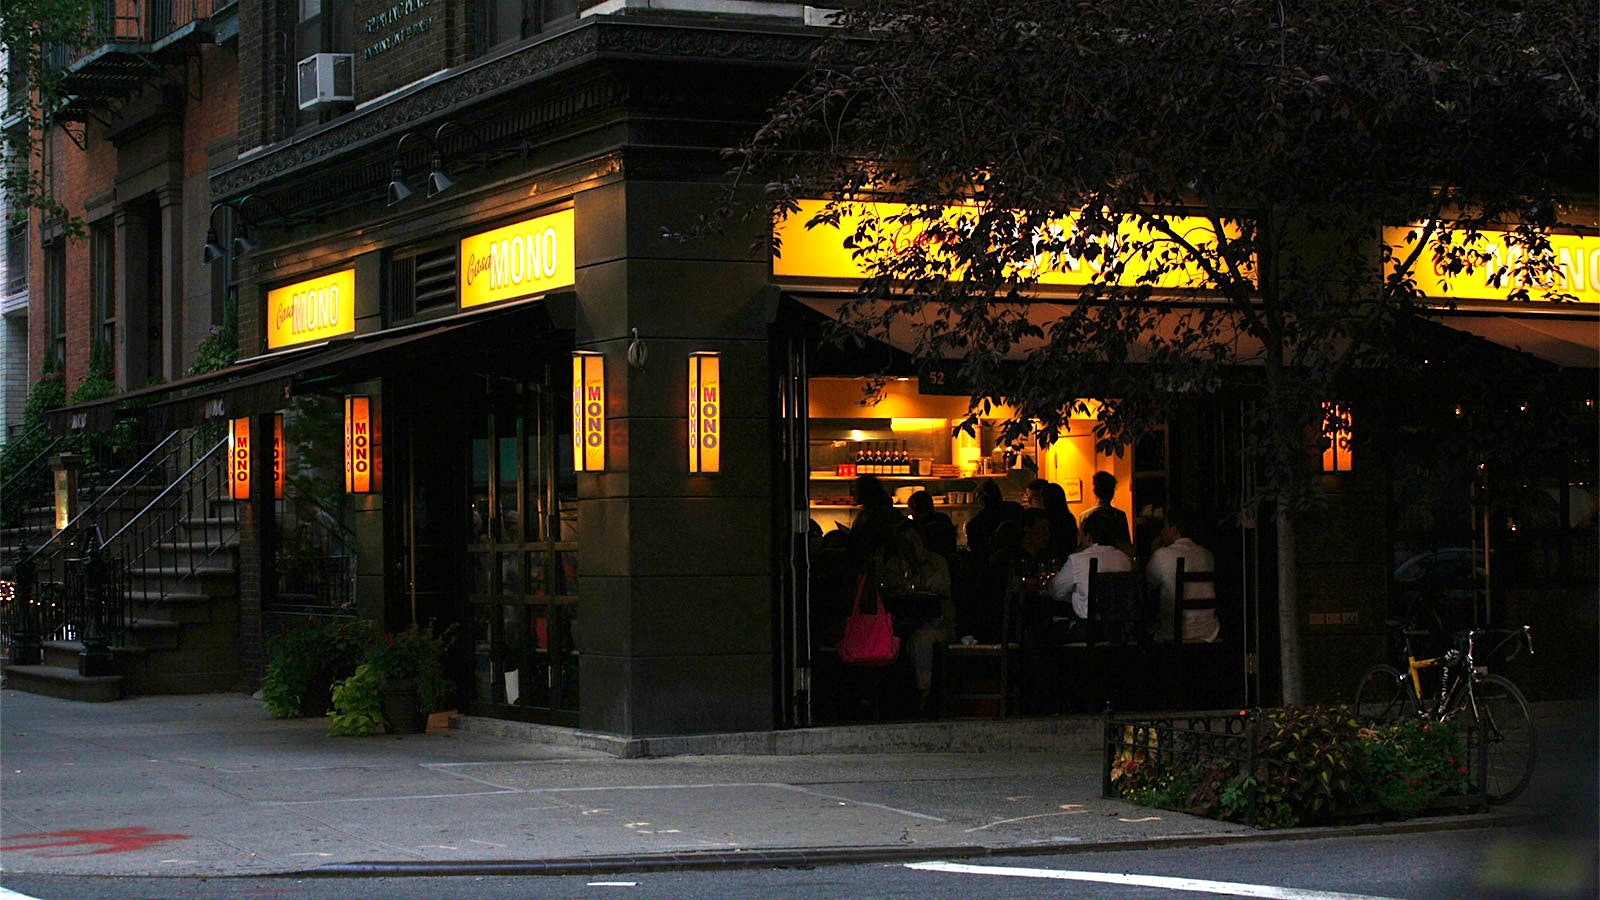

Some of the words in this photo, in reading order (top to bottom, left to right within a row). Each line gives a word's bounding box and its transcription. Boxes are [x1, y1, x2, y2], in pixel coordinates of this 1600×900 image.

[466, 253, 491, 286] Casa
[490, 225, 557, 292] MONO
[292, 283, 339, 336] MONO
[930, 371, 945, 385] 52
[587, 386, 602, 448] MONO
[703, 387, 718, 449] MONO
[237, 437, 248, 482] MONO
[355, 422, 368, 473] MONO
